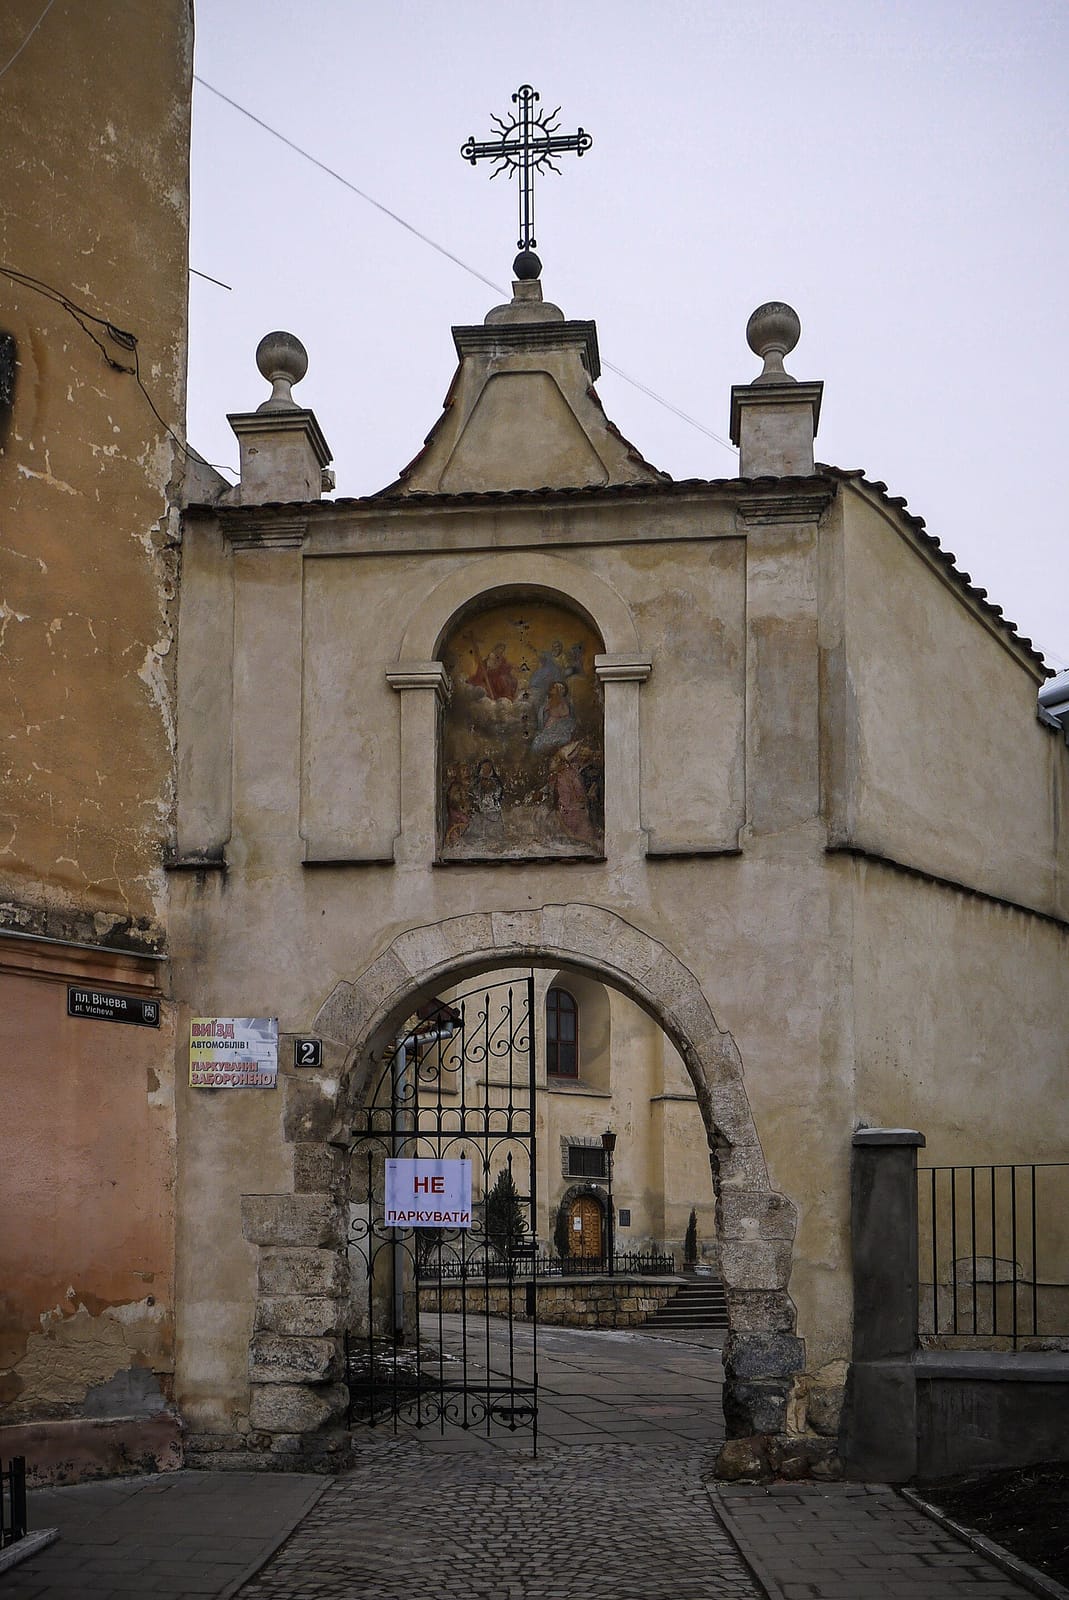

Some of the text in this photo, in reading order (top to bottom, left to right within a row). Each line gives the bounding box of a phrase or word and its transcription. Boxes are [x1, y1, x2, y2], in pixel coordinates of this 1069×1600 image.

[75, 993, 127, 1009] пл. Вічева
[75, 1004, 113, 1016] pl. Vicheva
[192, 1020, 234, 1039] ВИЇЗД
[301, 1042, 315, 1064] 2
[192, 1073, 277, 1085] ЗАБОРОНЕНО!
[414, 1176, 445, 1193] НЕ
[388, 1210, 469, 1222] ПАРКУВАТИ
